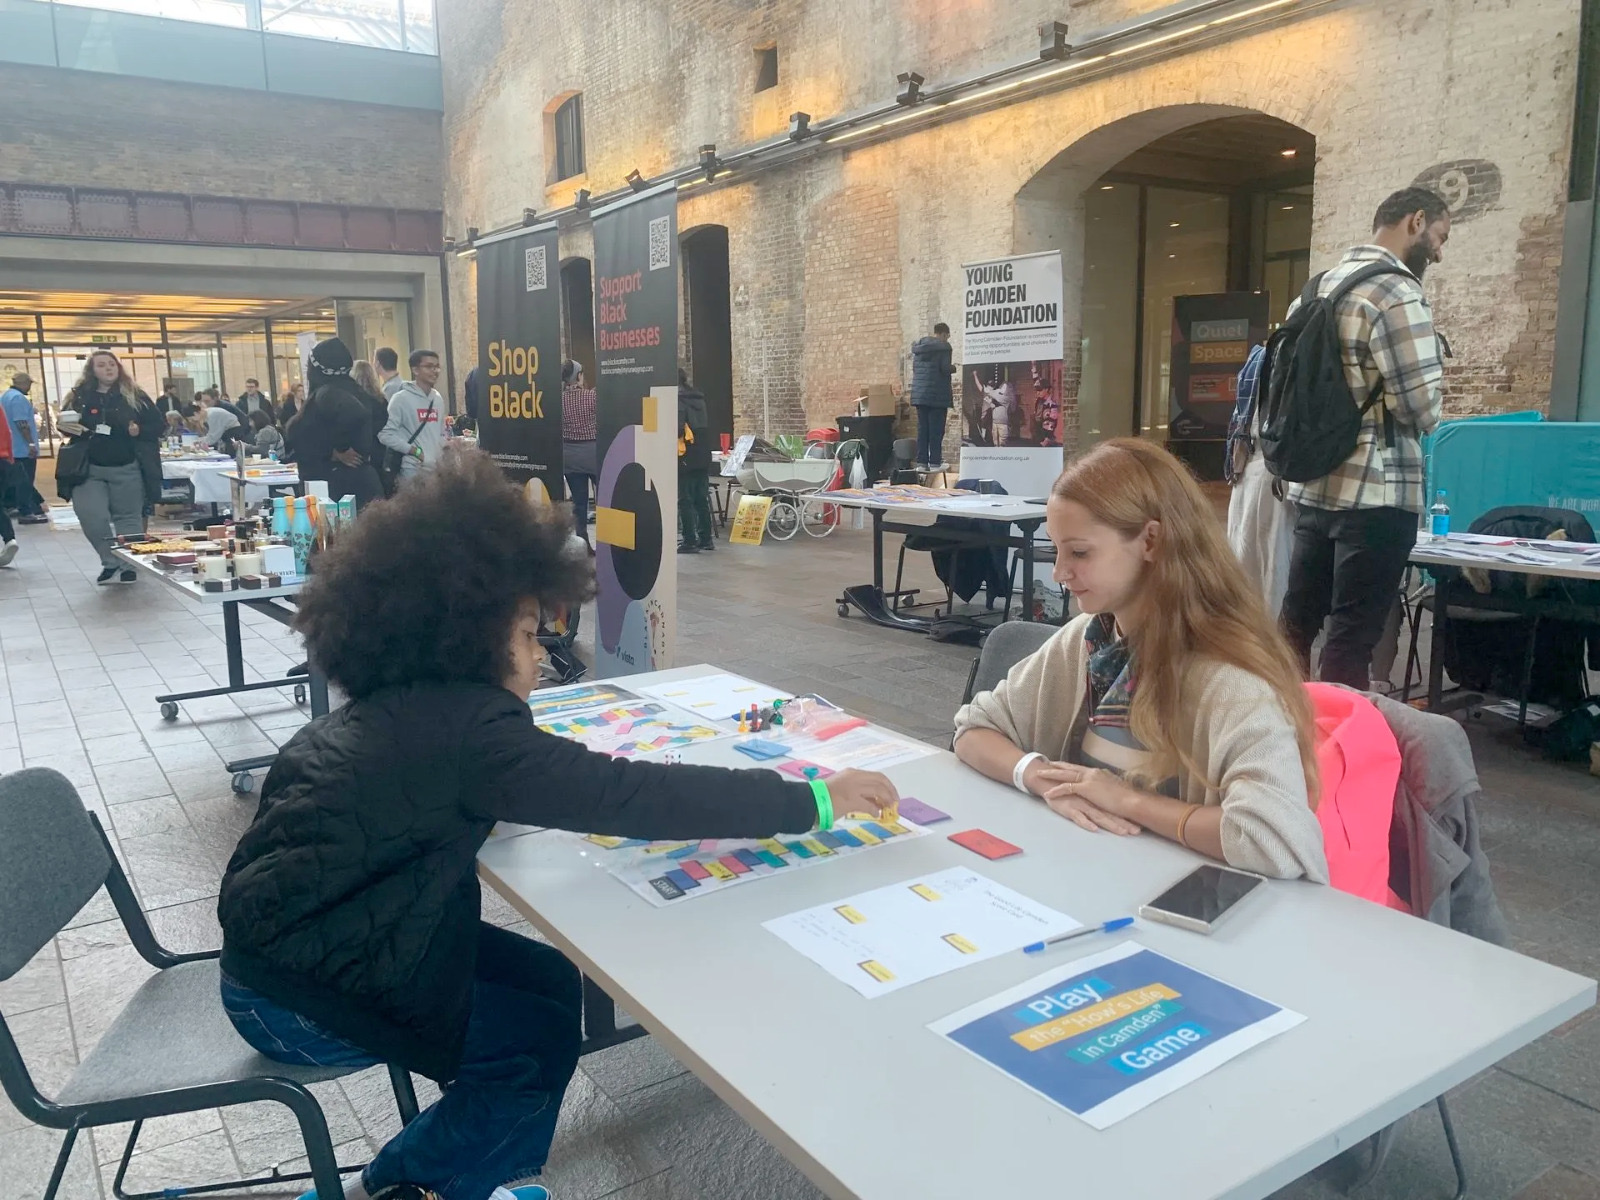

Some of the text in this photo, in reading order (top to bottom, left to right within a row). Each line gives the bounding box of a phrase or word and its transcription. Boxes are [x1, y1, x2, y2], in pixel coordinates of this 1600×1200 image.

[1438, 169, 1469, 213] 9
[600, 270, 643, 301] Support
[965, 263, 1013, 286] YOUNG
[965, 283, 1027, 308] CAMDEN
[600, 300, 628, 324] Black
[965, 302, 1058, 329] FOUNDATION
[600, 325, 660, 351] Businesses
[1196, 324, 1243, 338] Quiet
[488, 339, 539, 385] Shop
[1195, 344, 1243, 362] Space
[489, 380, 544, 418] Black
[1562, 497, 1577, 510] ARE
[652, 880, 678, 895] START
[1027, 983, 1103, 1019] Play
[1029, 1024, 1066, 1043] the
[1126, 988, 1165, 1010] Life
[1077, 1045, 1105, 1059] in
[1120, 1027, 1201, 1069] Game
